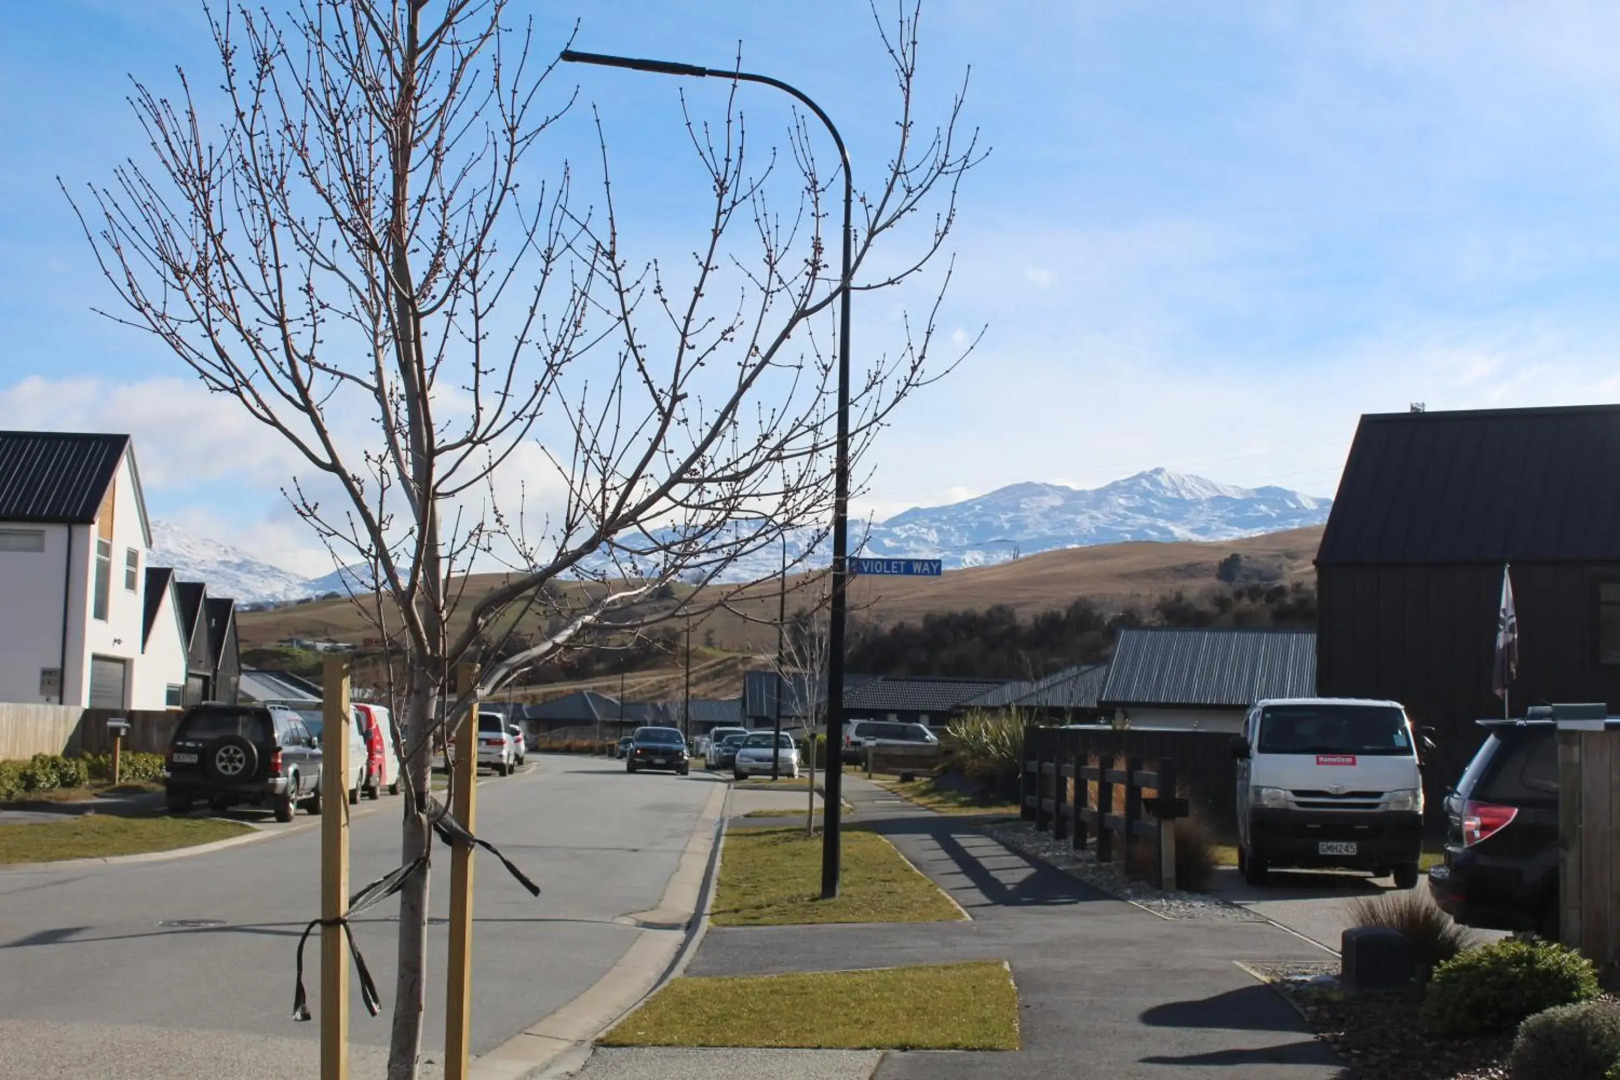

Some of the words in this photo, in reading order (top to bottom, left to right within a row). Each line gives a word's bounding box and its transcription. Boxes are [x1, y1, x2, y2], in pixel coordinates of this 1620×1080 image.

[861, 560, 906, 574] VIOLET
[912, 561, 939, 574] WAY
[1320, 843, 1356, 854] GMH245
